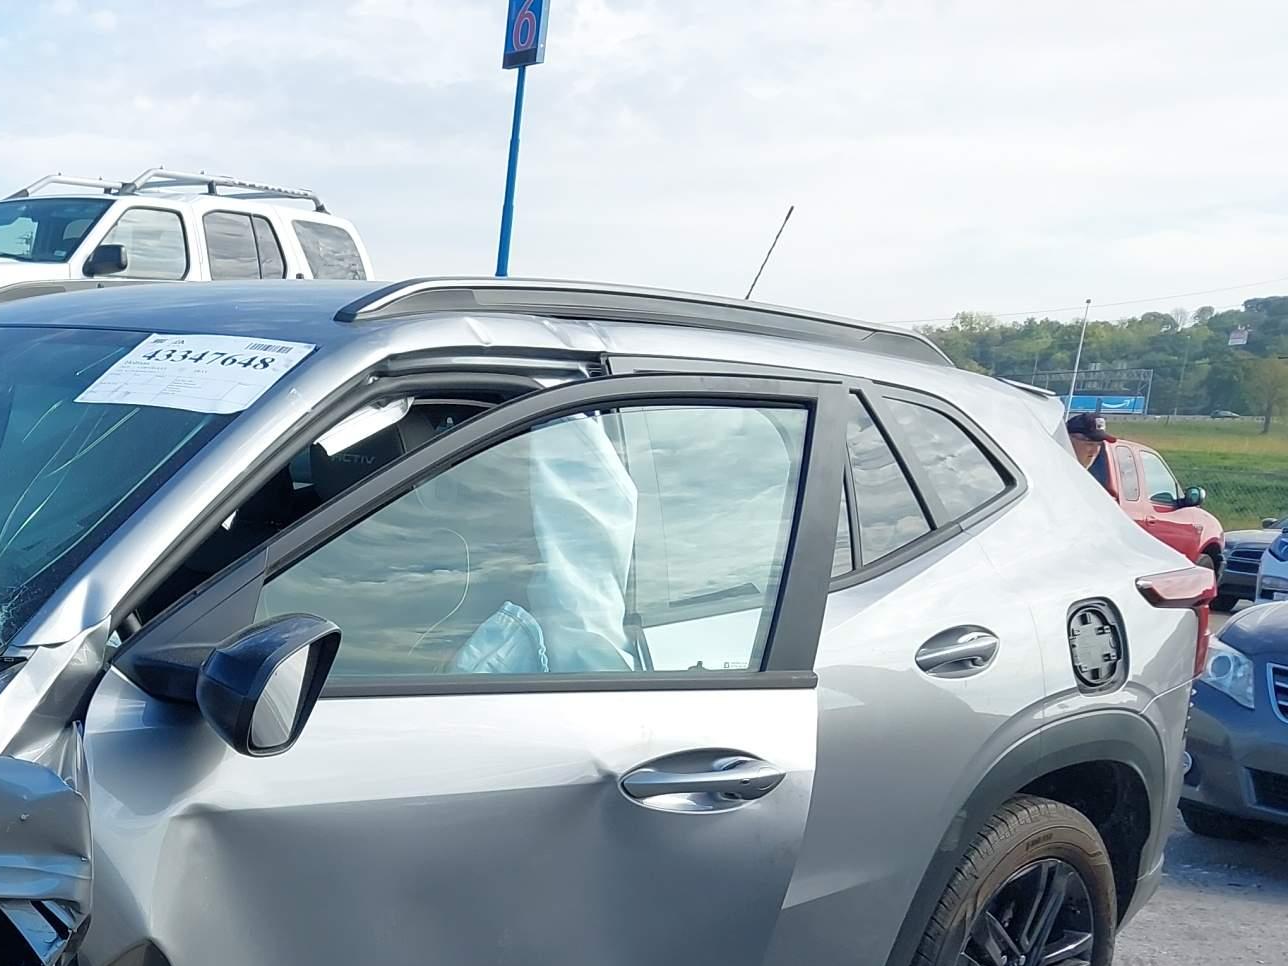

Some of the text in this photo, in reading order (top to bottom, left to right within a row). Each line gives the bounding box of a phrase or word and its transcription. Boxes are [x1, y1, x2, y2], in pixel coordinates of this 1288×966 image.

[513, 0, 537, 51] 6
[142, 349, 276, 371] 43347648
[330, 453, 376, 465] ACTIV
